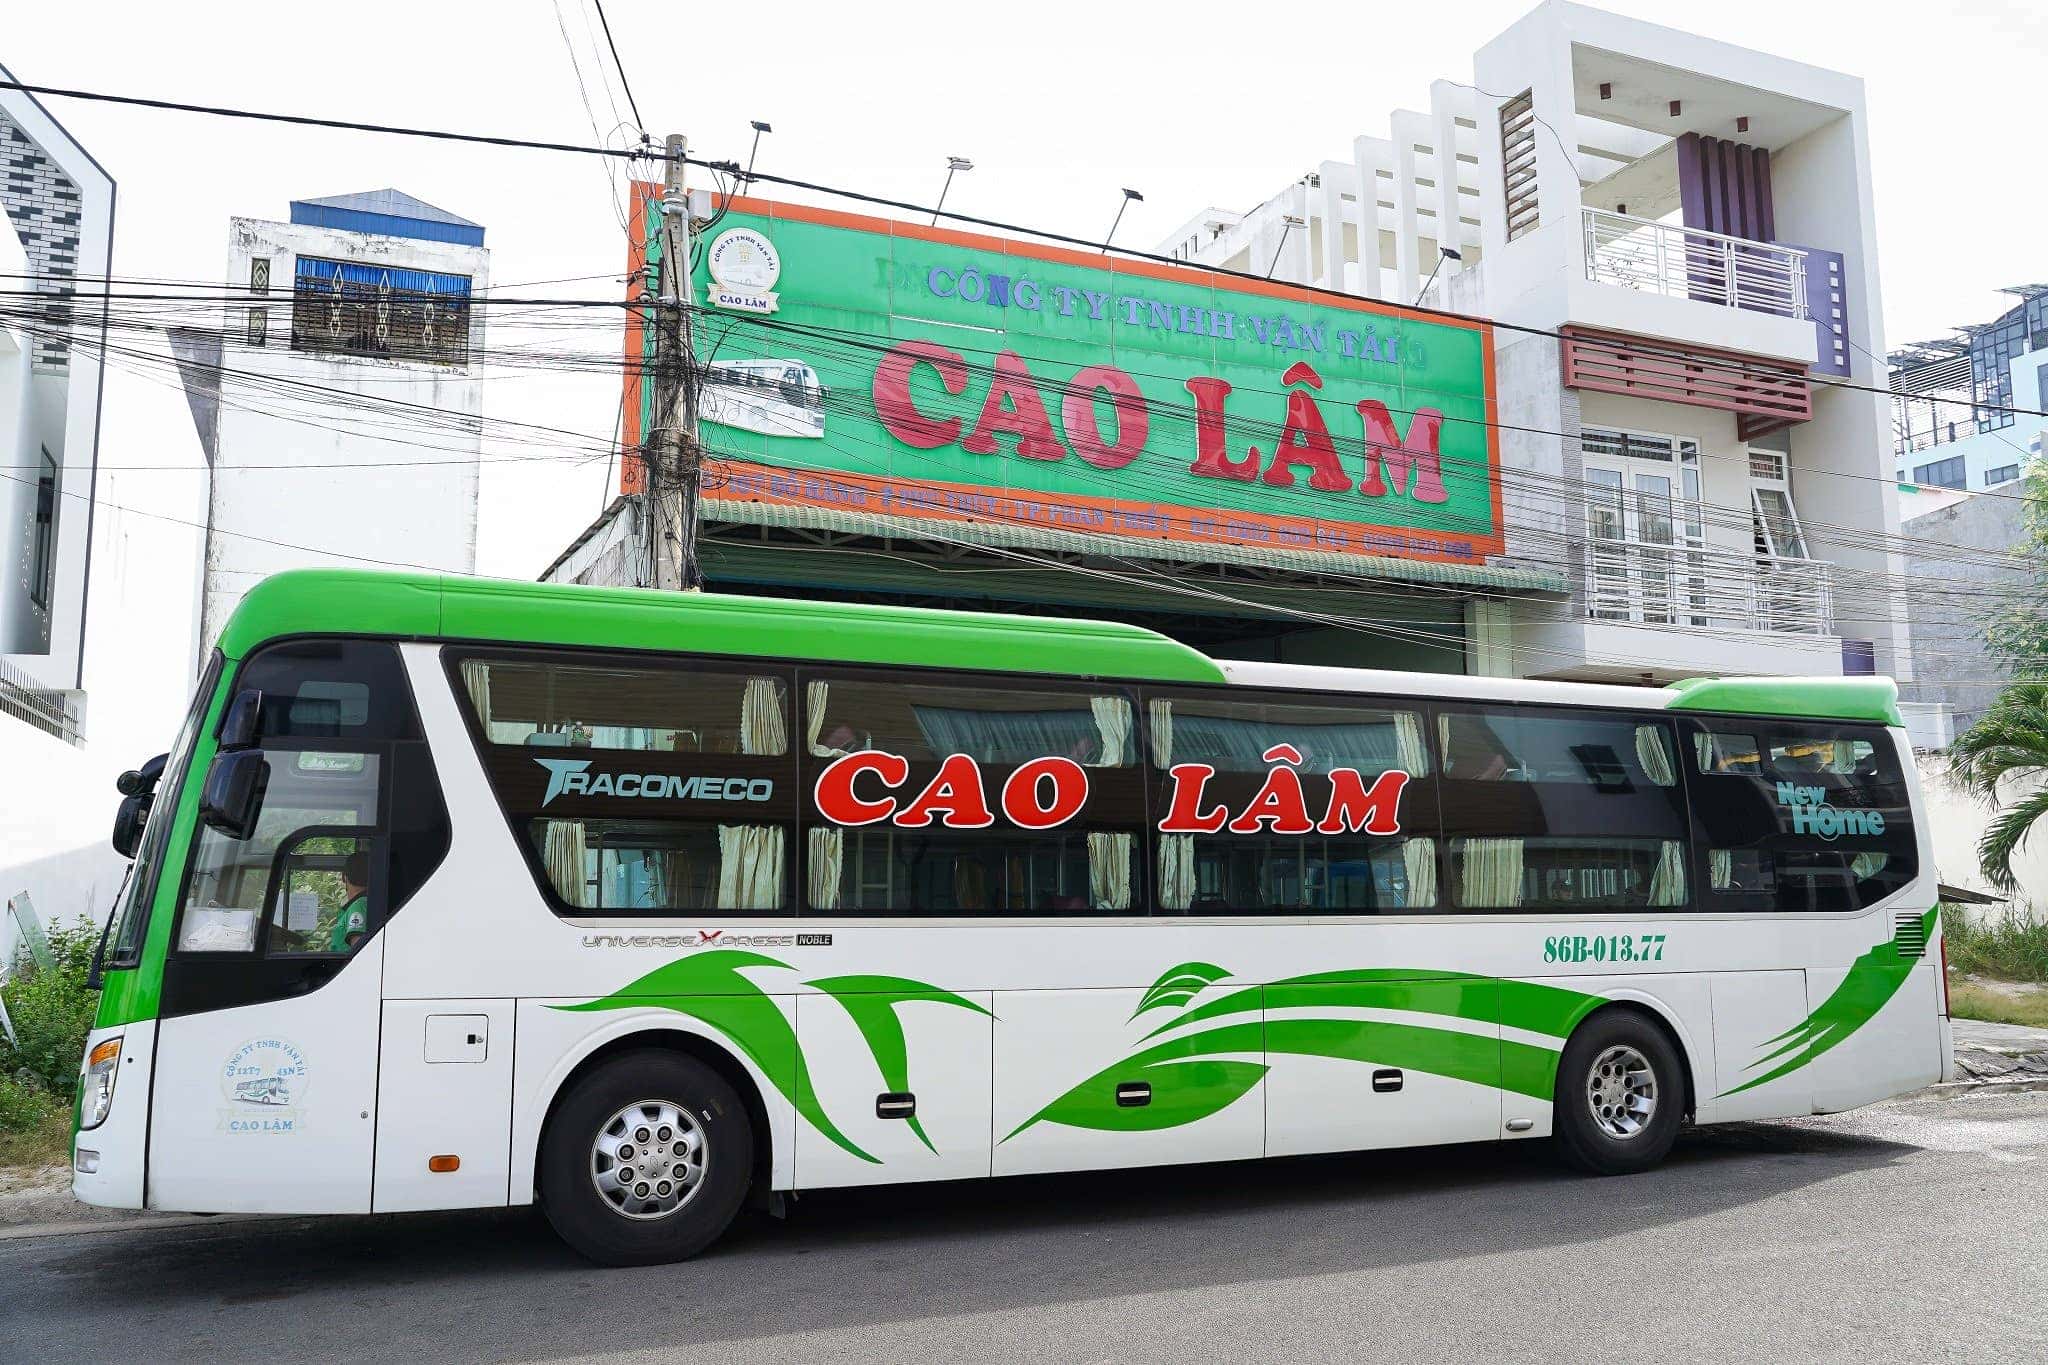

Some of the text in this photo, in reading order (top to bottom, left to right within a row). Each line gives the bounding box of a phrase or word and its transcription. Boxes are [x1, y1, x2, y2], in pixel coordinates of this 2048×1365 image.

[720, 295, 767, 308] CAO LÂM
[928, 264, 1041, 311] CÔNG
[1052, 286, 1109, 320] TY
[1119, 296, 1236, 340] TNHH
[1249, 314, 1324, 354] VẬN
[1337, 324, 1399, 364] TẢI
[872, 338, 1449, 503] CAO LÂM
[533, 758, 773, 808] TRACOMECO
[814, 743, 1409, 835] CAO LÂM
[1776, 781, 1825, 806] New
[1792, 803, 1885, 839] Home
[798, 934, 831, 946] NOBLE
[1543, 934, 1666, 963] 86B-013.77
[256, 1040, 281, 1049] TNHH
[230, 1118, 293, 1130] CAO LÂM
